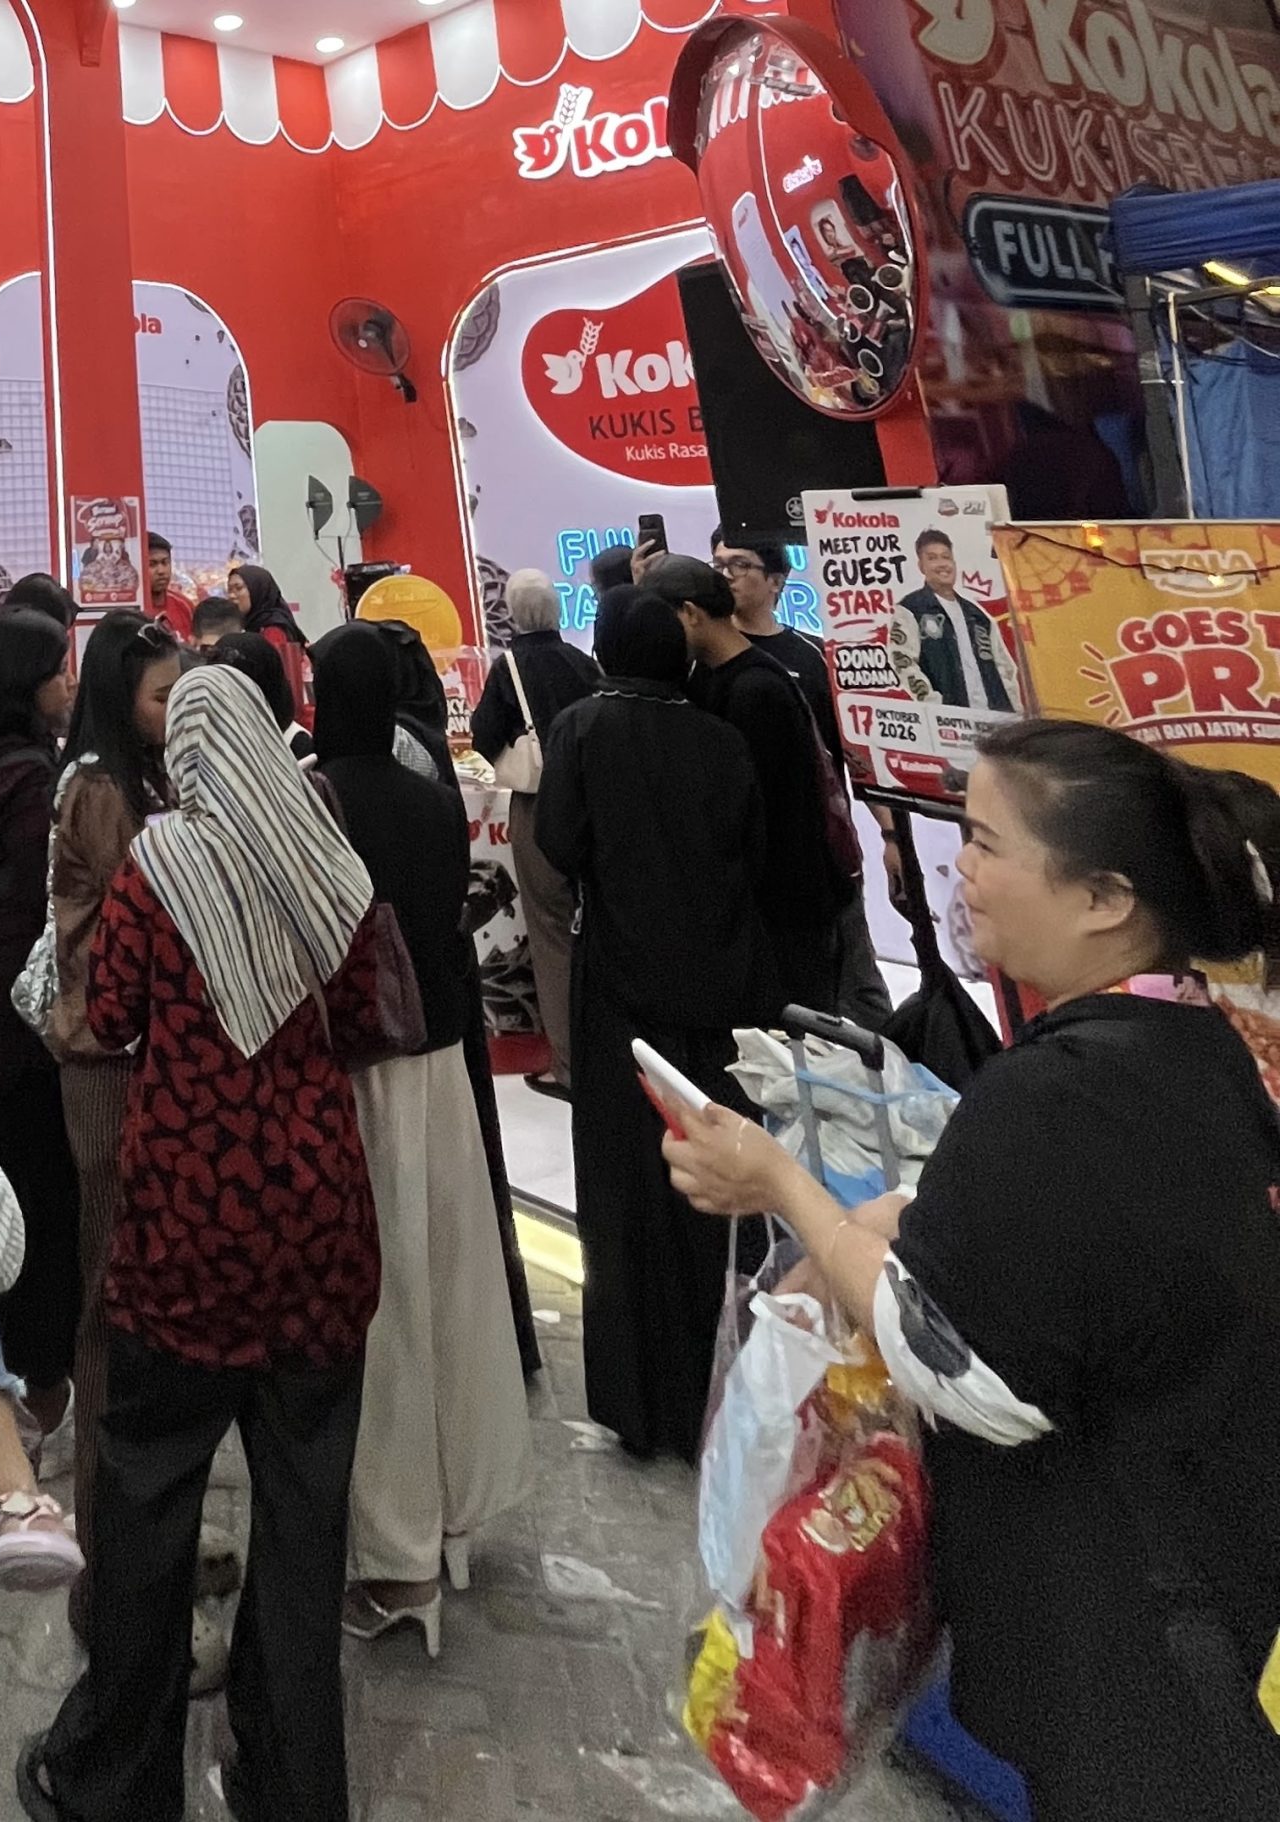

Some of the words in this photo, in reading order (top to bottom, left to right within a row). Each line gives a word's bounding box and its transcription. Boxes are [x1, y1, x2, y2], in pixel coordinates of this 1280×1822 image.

[992, 219, 1097, 282] FULL
[588, 408, 676, 441] KUKIS
[625, 443, 666, 462] Kukis
[668, 442, 708, 459] Rasa
[832, 511, 900, 529] Kokola
[819, 535, 861, 557] MEET
[866, 533, 902, 552] OUR
[823, 555, 908, 587] GUEST
[826, 588, 896, 617] STAR!
[1119, 610, 1251, 654] GOES
[837, 647, 887, 669] DONO
[837, 670, 899, 687] PRADANA
[847, 704, 873, 737] 17
[875, 708, 922, 725] OKTOBER
[935, 716, 973, 731] BOOTH
[878, 721, 918, 742] 2026
